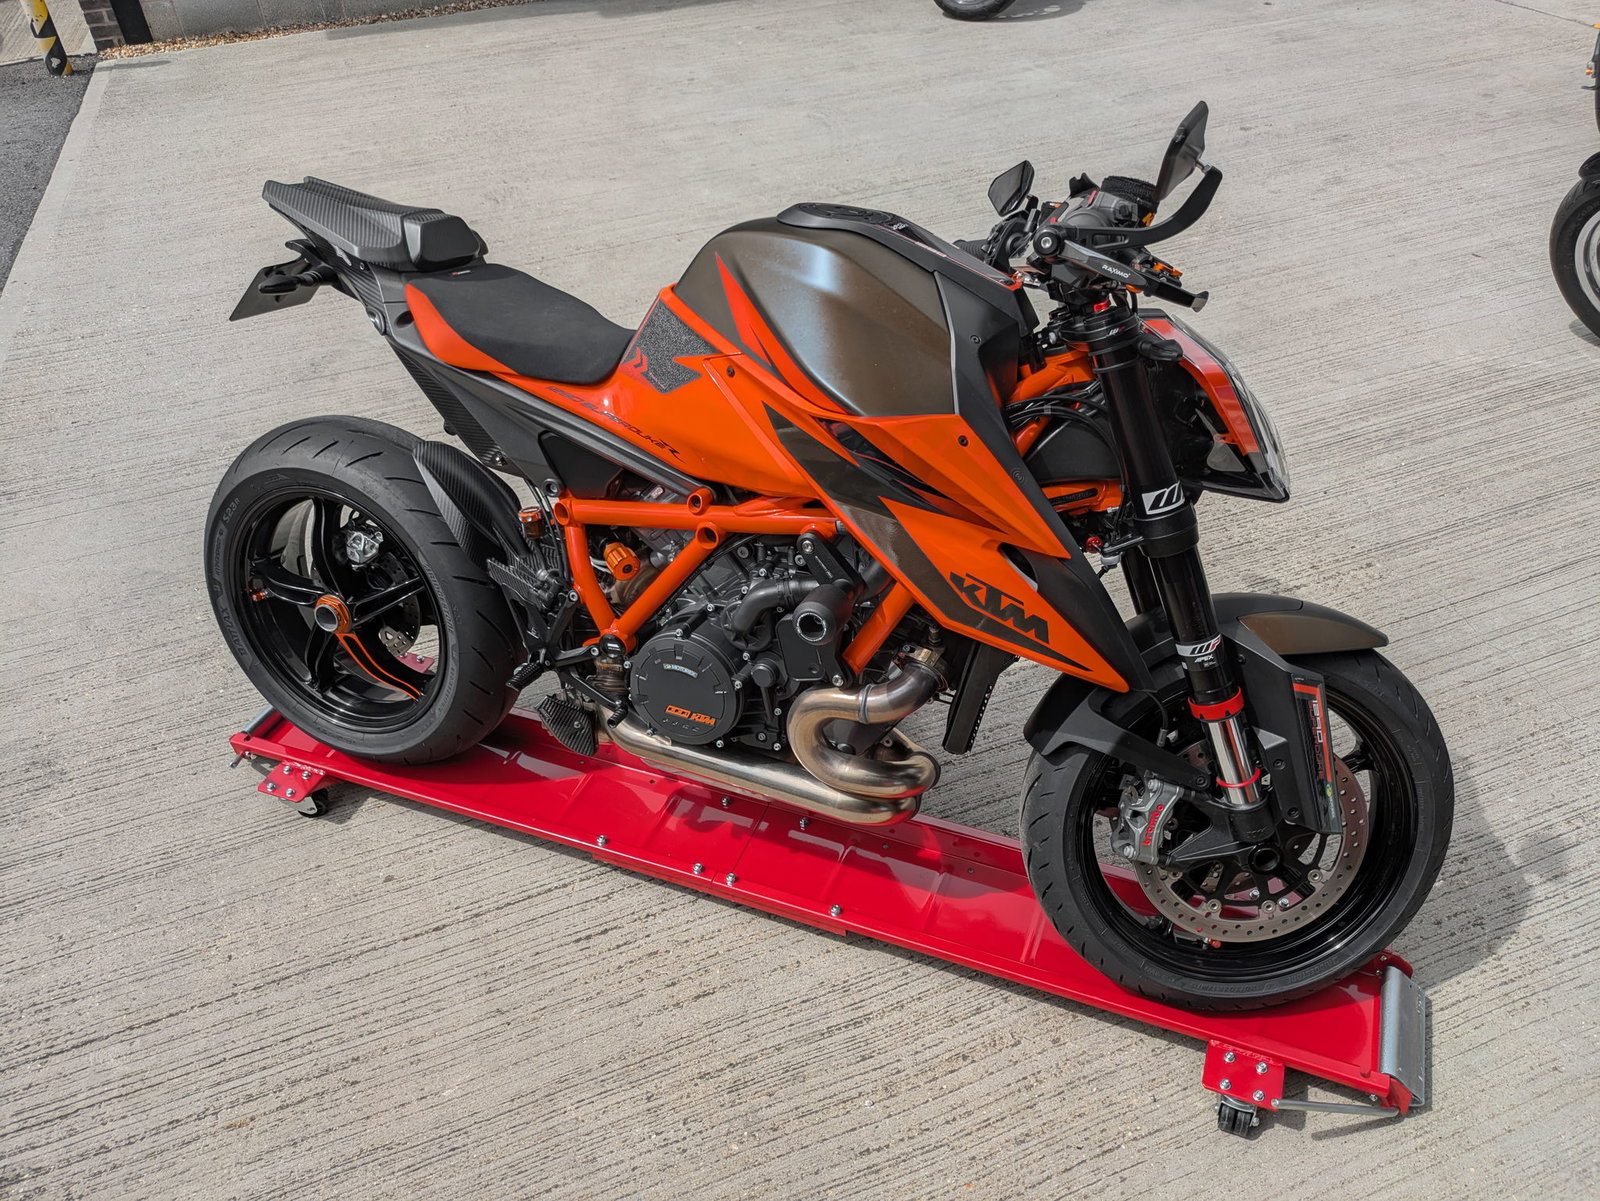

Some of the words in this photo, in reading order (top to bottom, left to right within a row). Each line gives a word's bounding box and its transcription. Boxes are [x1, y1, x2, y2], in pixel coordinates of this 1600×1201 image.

[1102, 264, 1129, 279] RAXIMO
[950, 572, 1049, 644] KTM
[1142, 804, 1165, 846] brembo
